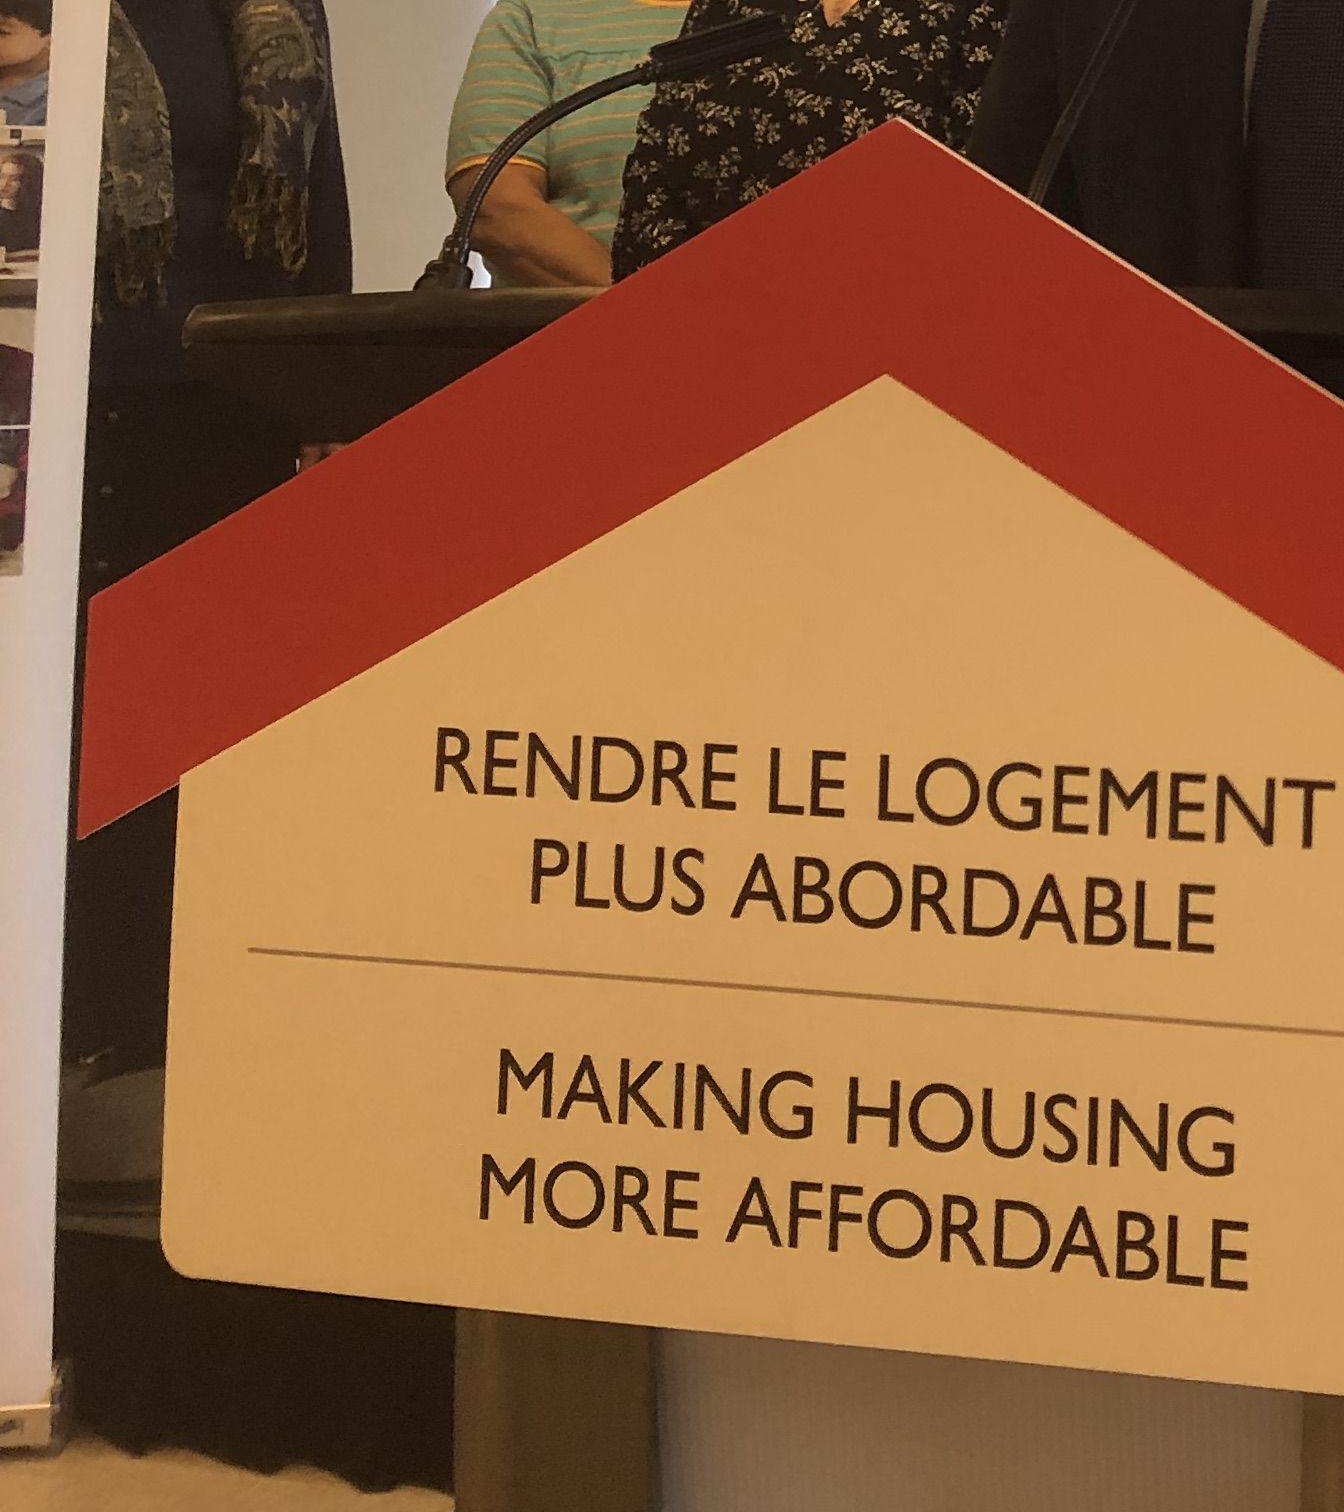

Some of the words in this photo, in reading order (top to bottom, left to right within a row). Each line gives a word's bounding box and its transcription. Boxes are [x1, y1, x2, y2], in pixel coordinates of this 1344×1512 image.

[434, 726, 738, 812] RENDRE
[768, 746, 847, 819] LE
[877, 754, 1336, 851] LOGEMENT
[530, 838, 705, 916] PLUS
[729, 852, 1216, 954] ABORDABLE
[496, 1047, 814, 1140] MAKING
[846, 1076, 1236, 1178] HOUSING
[479, 1153, 701, 1240] MORE
[724, 1176, 1249, 1292] AFFORDABLE
